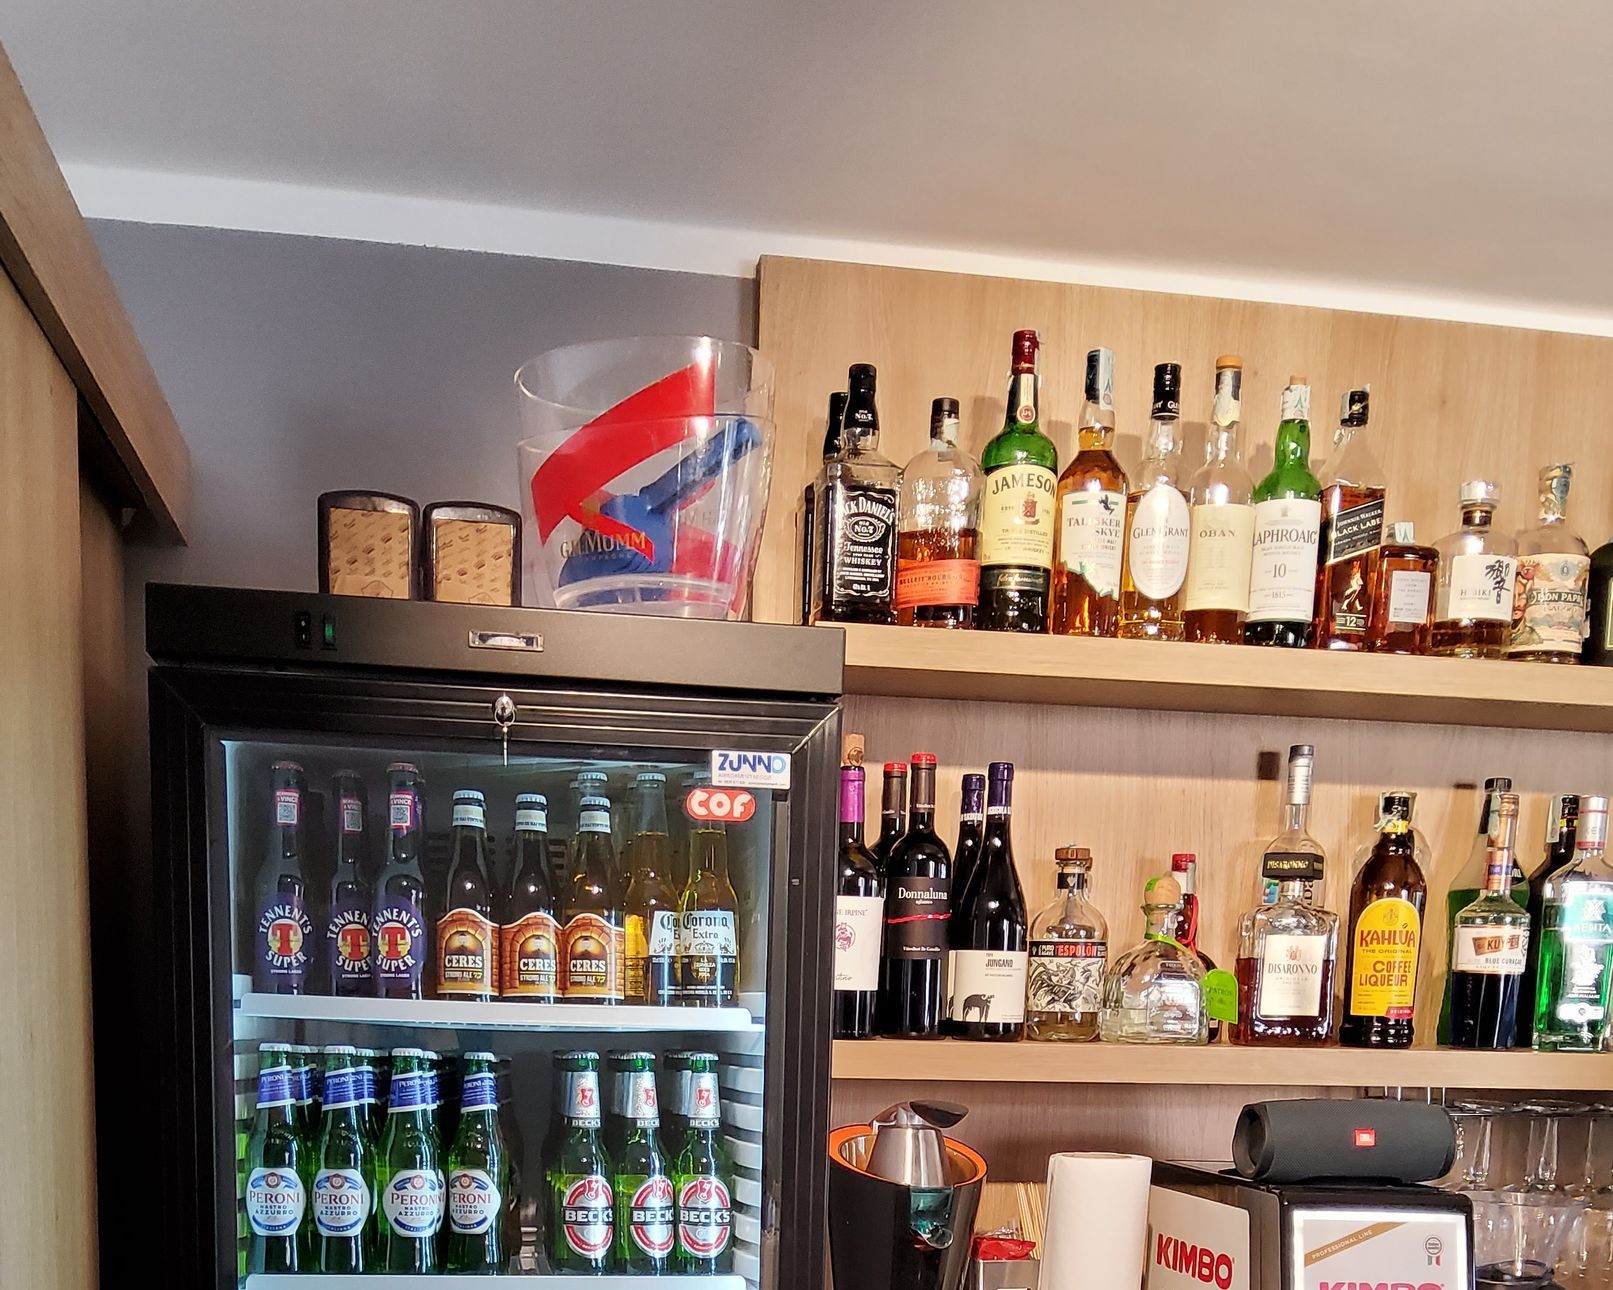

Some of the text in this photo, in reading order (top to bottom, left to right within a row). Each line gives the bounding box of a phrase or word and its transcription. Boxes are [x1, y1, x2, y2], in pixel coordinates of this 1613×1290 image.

[992, 473, 1056, 499] JAMESON
[859, 496, 896, 524] DANIEL'S
[1199, 529, 1237, 538] OBAN
[1335, 525, 1359, 538] LACK
[843, 541, 884, 554] Tennessee
[843, 556, 883, 567] WHISKEY
[1272, 562, 1287, 579] 10
[1345, 616, 1358, 628] 12
[690, 789, 752, 818] COF
[898, 887, 948, 900] Donnaluna
[259, 904, 314, 935] TENNENT'S
[682, 913, 729, 932] Corona
[692, 928, 719, 939] Extra
[1360, 923, 1416, 948] KAHLÚA
[265, 950, 309, 969] SUPER
[335, 955, 371, 972] SUPE
[375, 953, 417, 972] SUPER
[444, 955, 483, 969] CERES
[520, 959, 557, 971] CERES
[570, 959, 606, 972] CERES
[1268, 963, 1318, 975] DISARONNO
[1372, 960, 1412, 974] COFFEE
[1359, 973, 1408, 987] LIQUEUR
[250, 1190, 300, 1205] PERONI
[314, 1190, 364, 1205] PERONI
[450, 1192, 492, 1204] ERONI
[679, 1209, 731, 1222] BECK'S
[1311, 1229, 1374, 1260] PROFESSIONAL LINE
[1157, 1232, 1234, 1290] KIMBO
